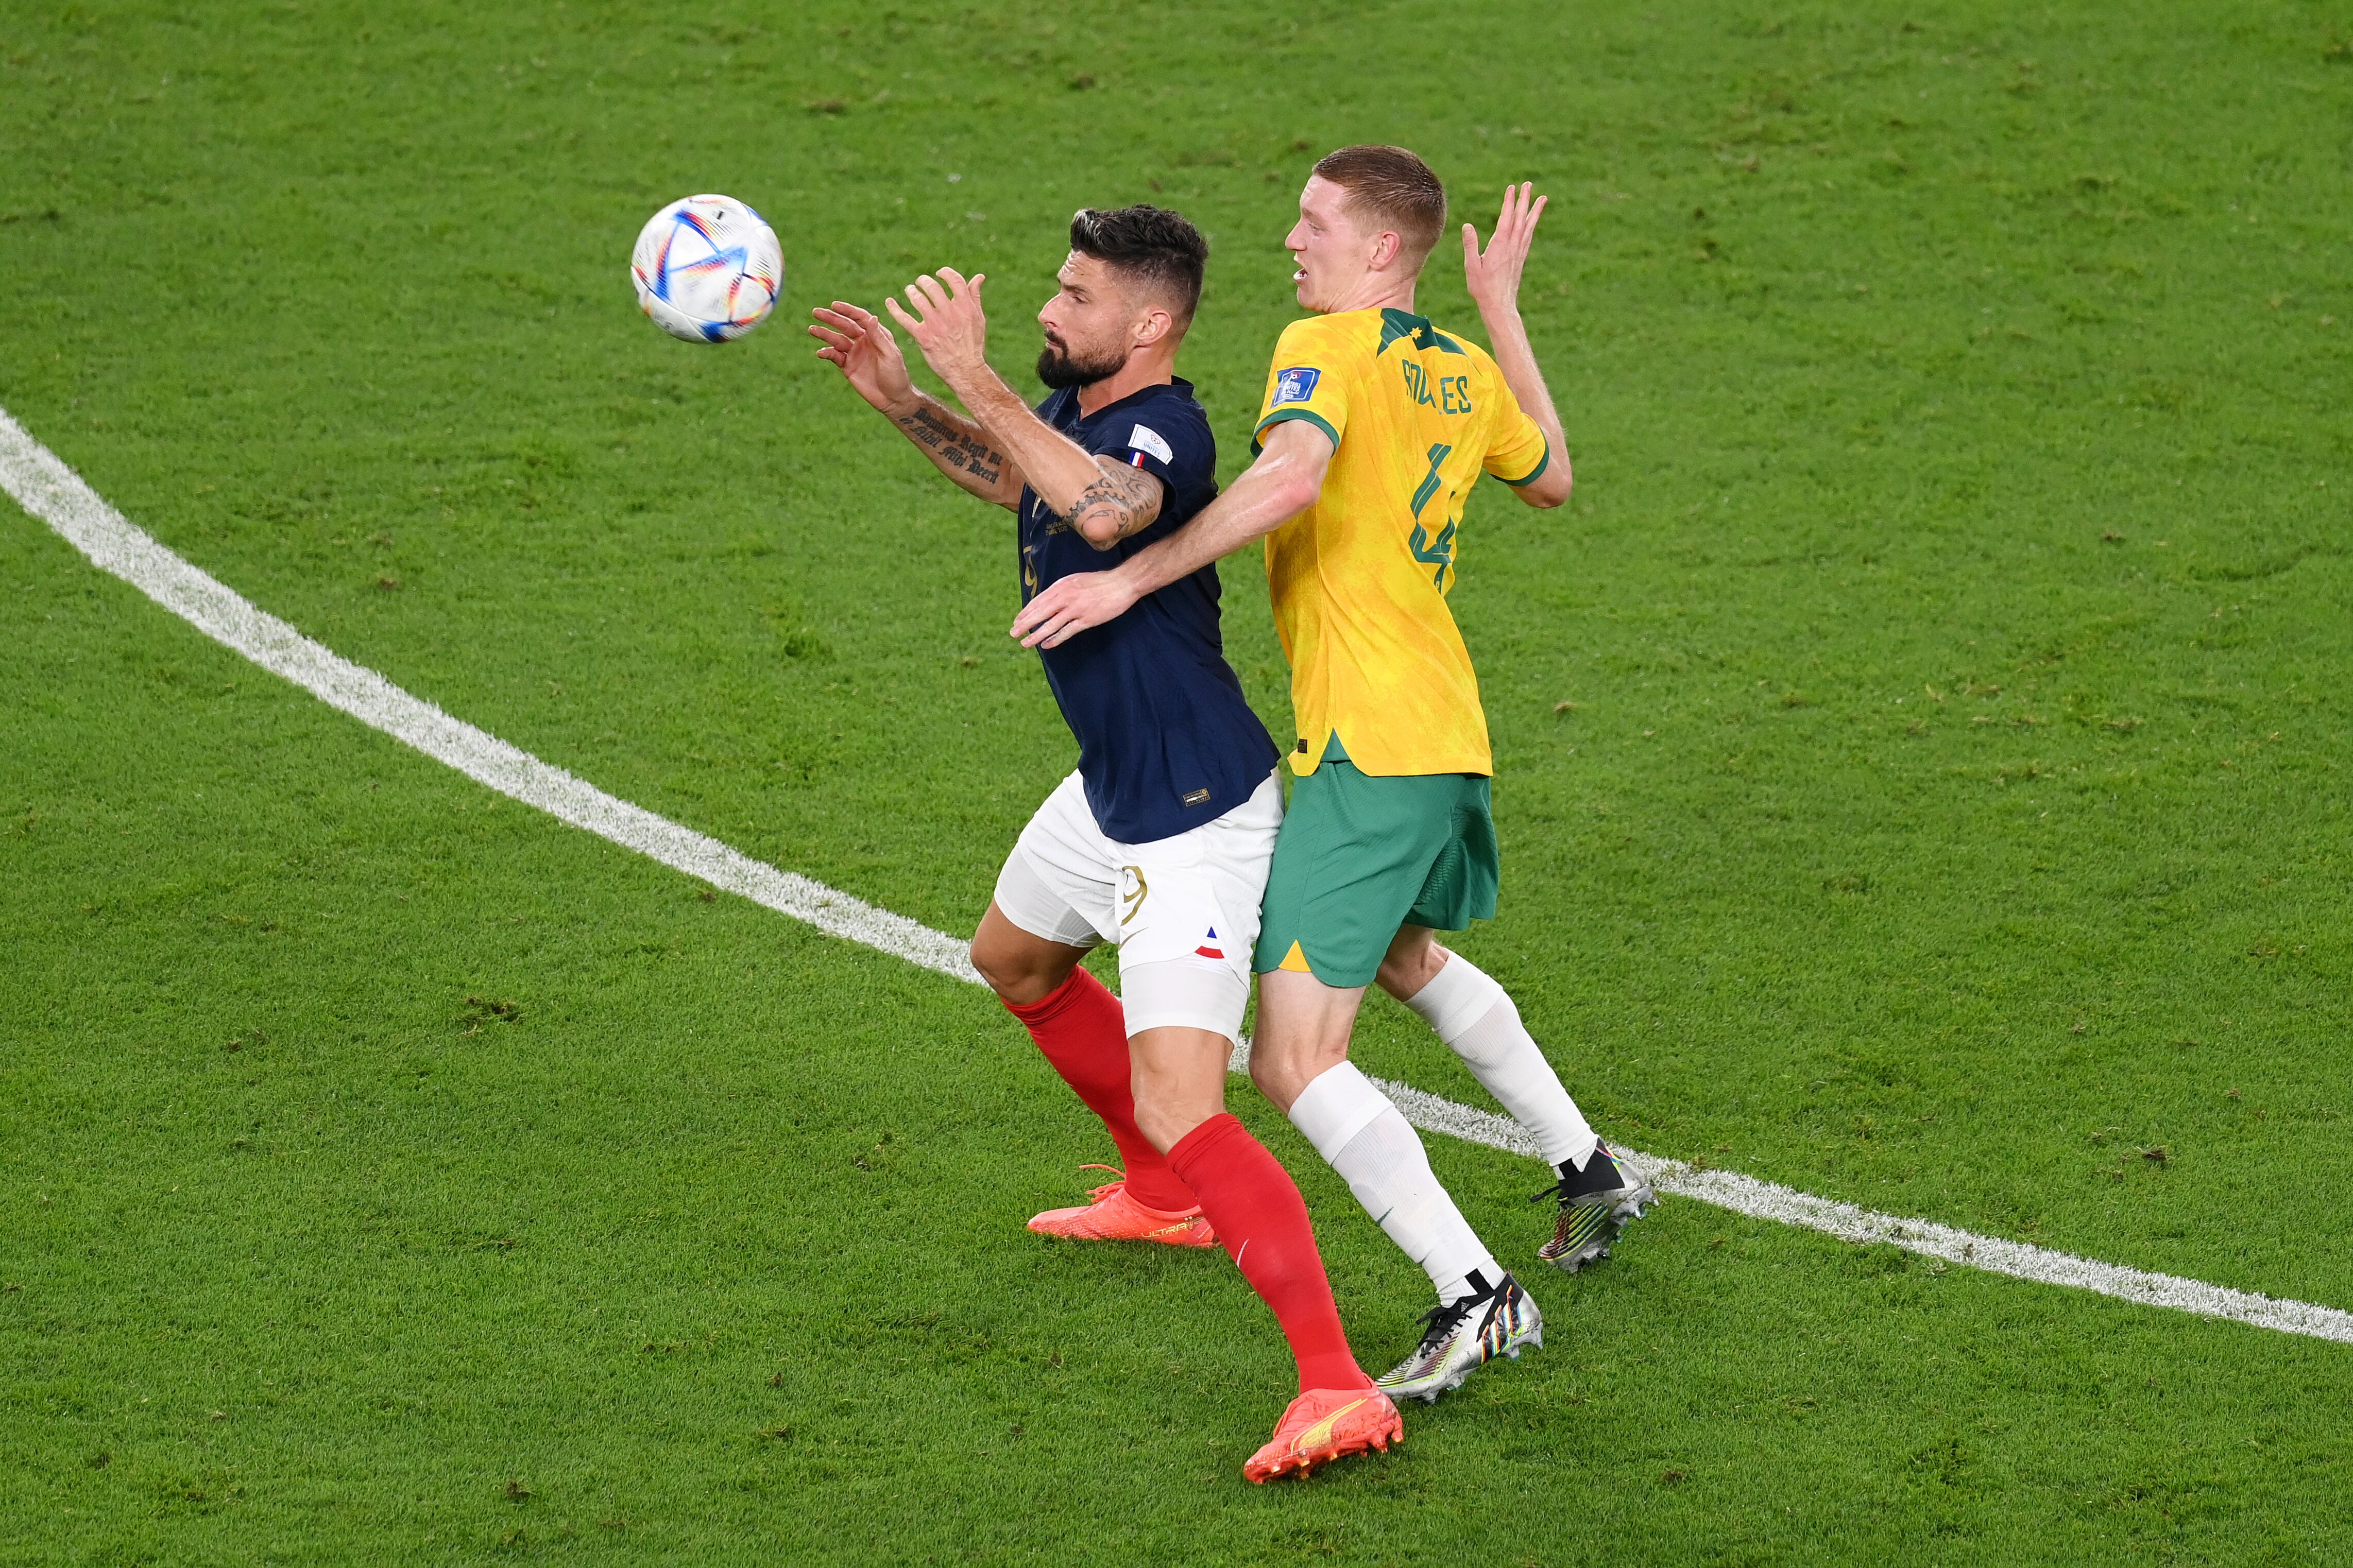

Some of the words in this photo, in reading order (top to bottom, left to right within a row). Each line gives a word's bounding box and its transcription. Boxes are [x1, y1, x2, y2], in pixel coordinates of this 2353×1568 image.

[1408, 443, 1456, 595] 4
[1120, 865, 1148, 926] 9
[1141, 1222, 1188, 1238] ULTRA
